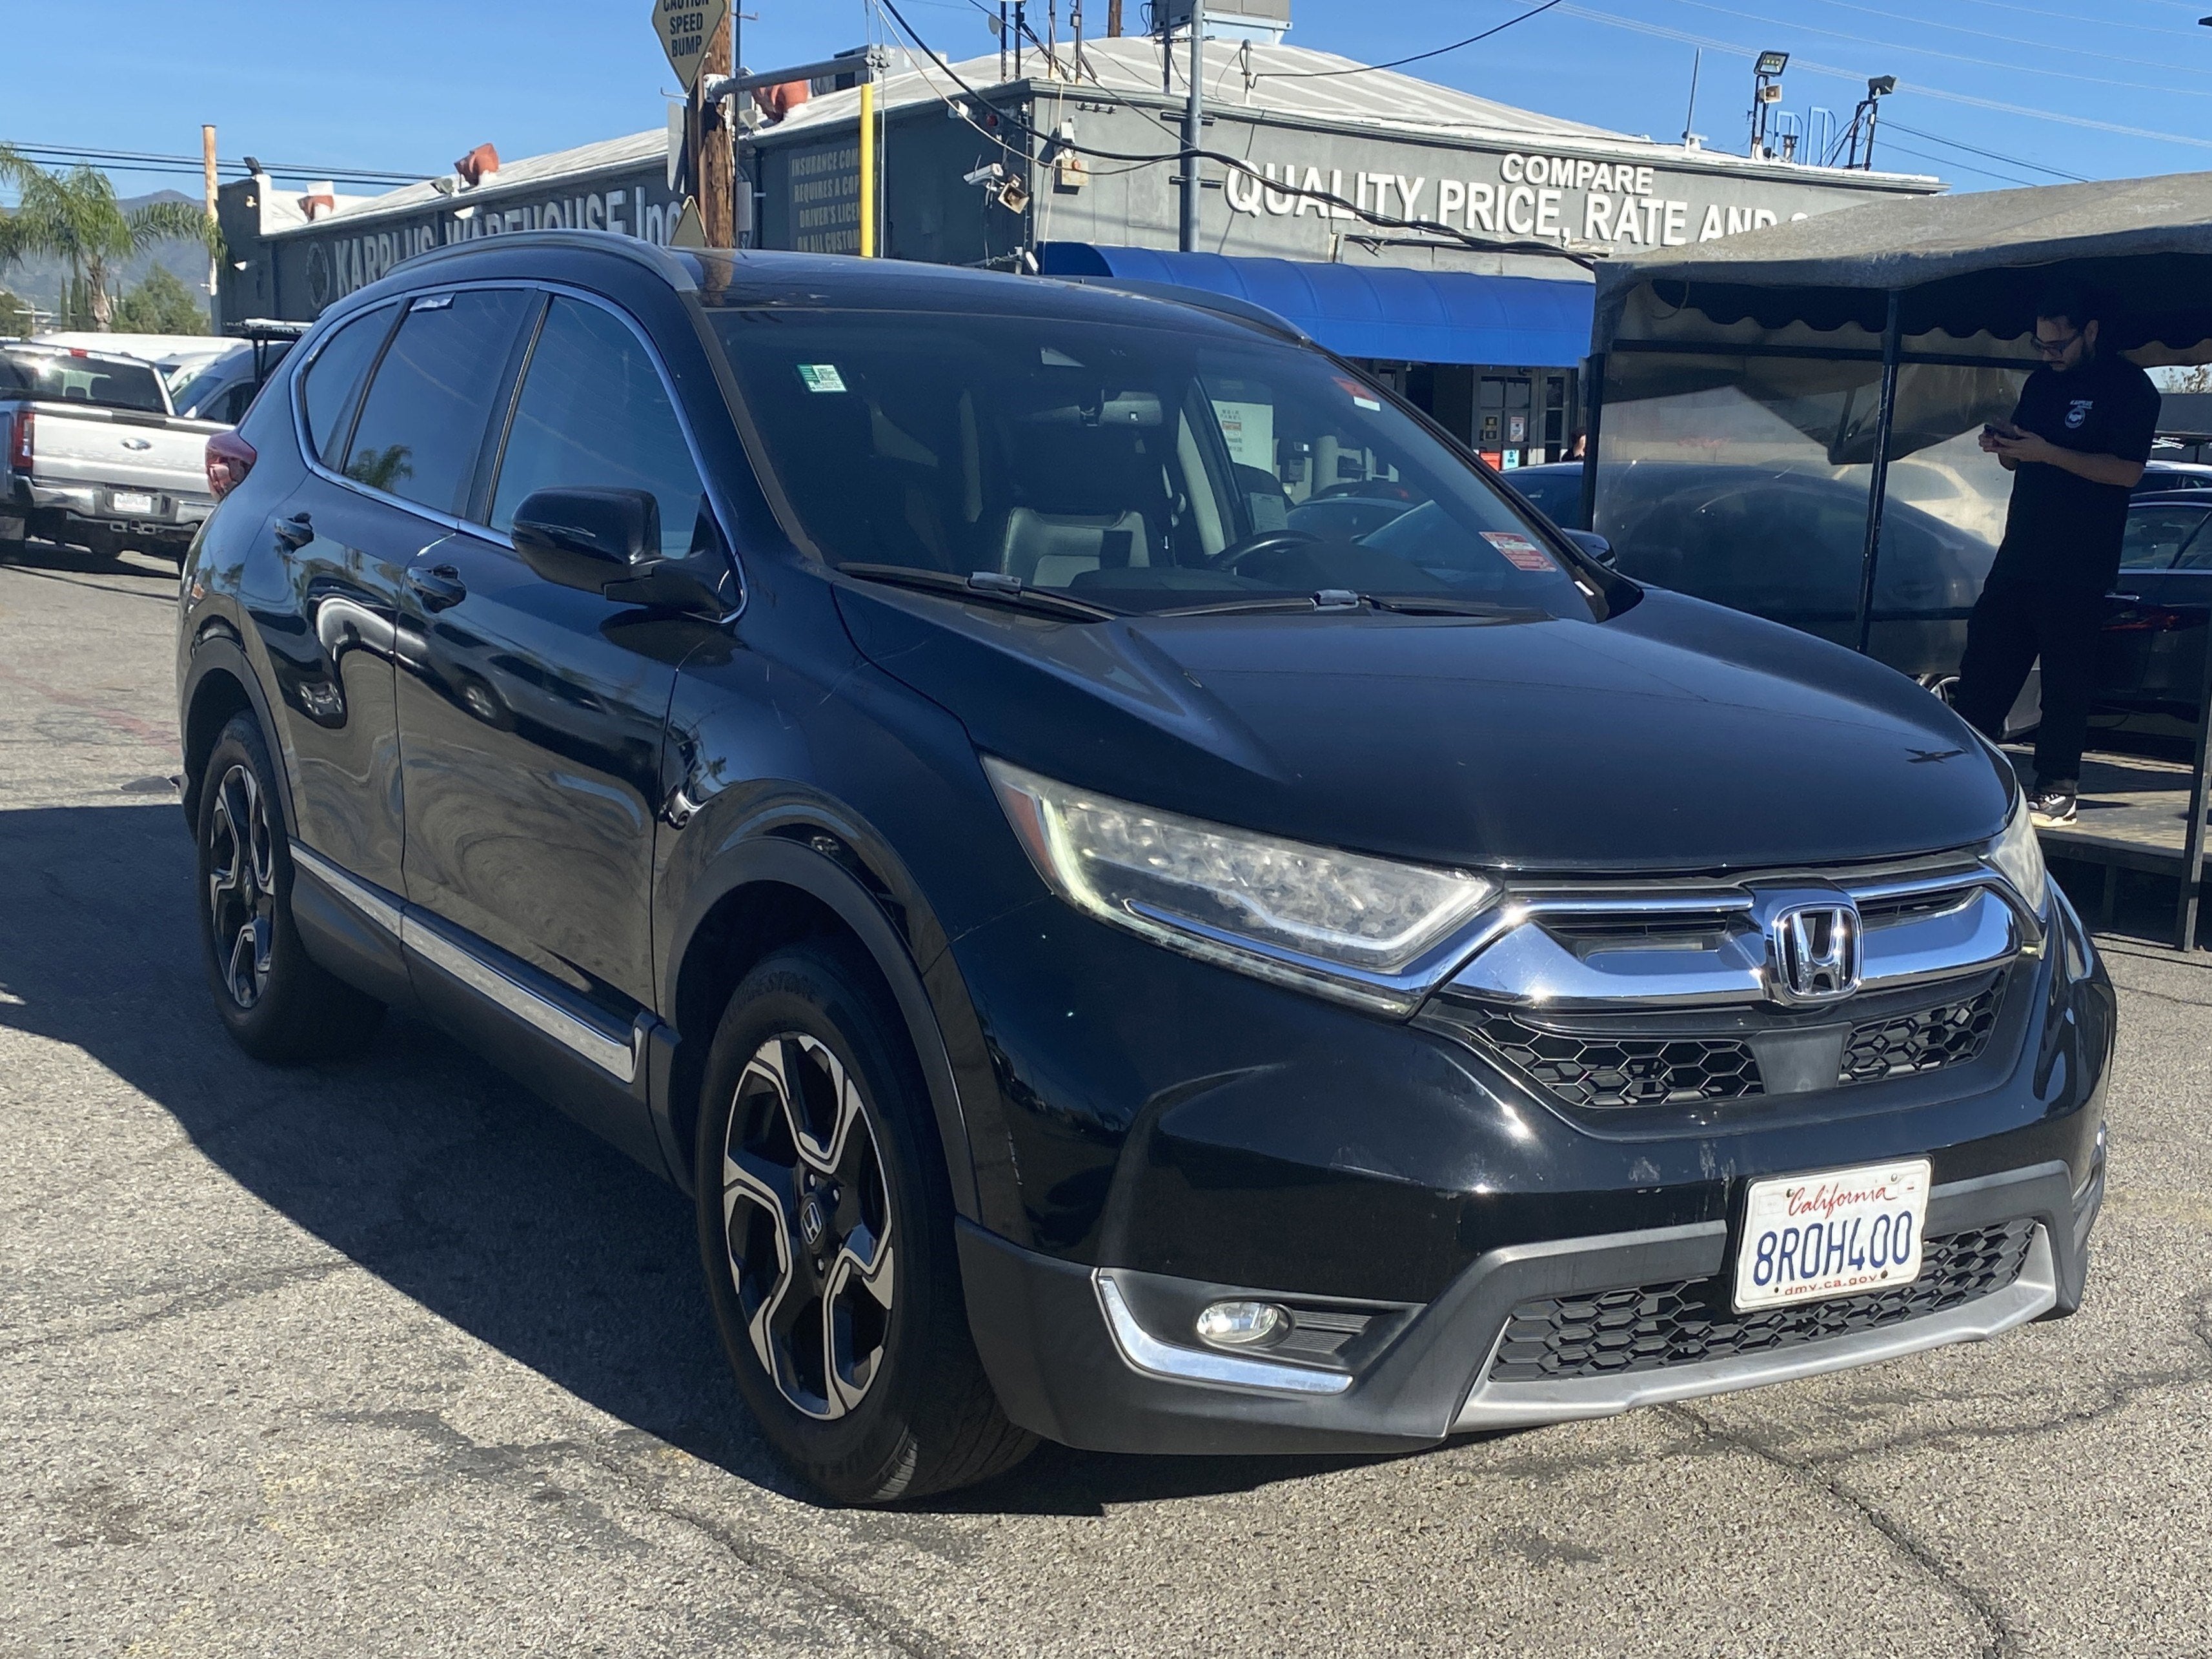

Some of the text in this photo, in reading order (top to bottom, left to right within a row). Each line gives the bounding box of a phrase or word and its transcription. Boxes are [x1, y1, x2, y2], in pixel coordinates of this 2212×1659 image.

[670, 12, 703, 35] SPEED
[672, 35, 702, 57] BUMP
[791, 151, 837, 177] INSURANCE
[1501, 154, 1654, 194] COMPARE
[794, 178, 833, 203] REQUIRES
[835, 178, 840, 196] A
[842, 174, 860, 196] COP
[799, 201, 860, 228] DRIVER'S LICE
[1437, 179, 1571, 247] PRICE,
[1583, 193, 1687, 247] RATE
[810, 234, 824, 252] ALL
[1788, 1183, 1898, 1219] California
[1753, 1210, 1912, 1287] 8ROH400
[1785, 1273, 1877, 1296] dmv.ca.gov
